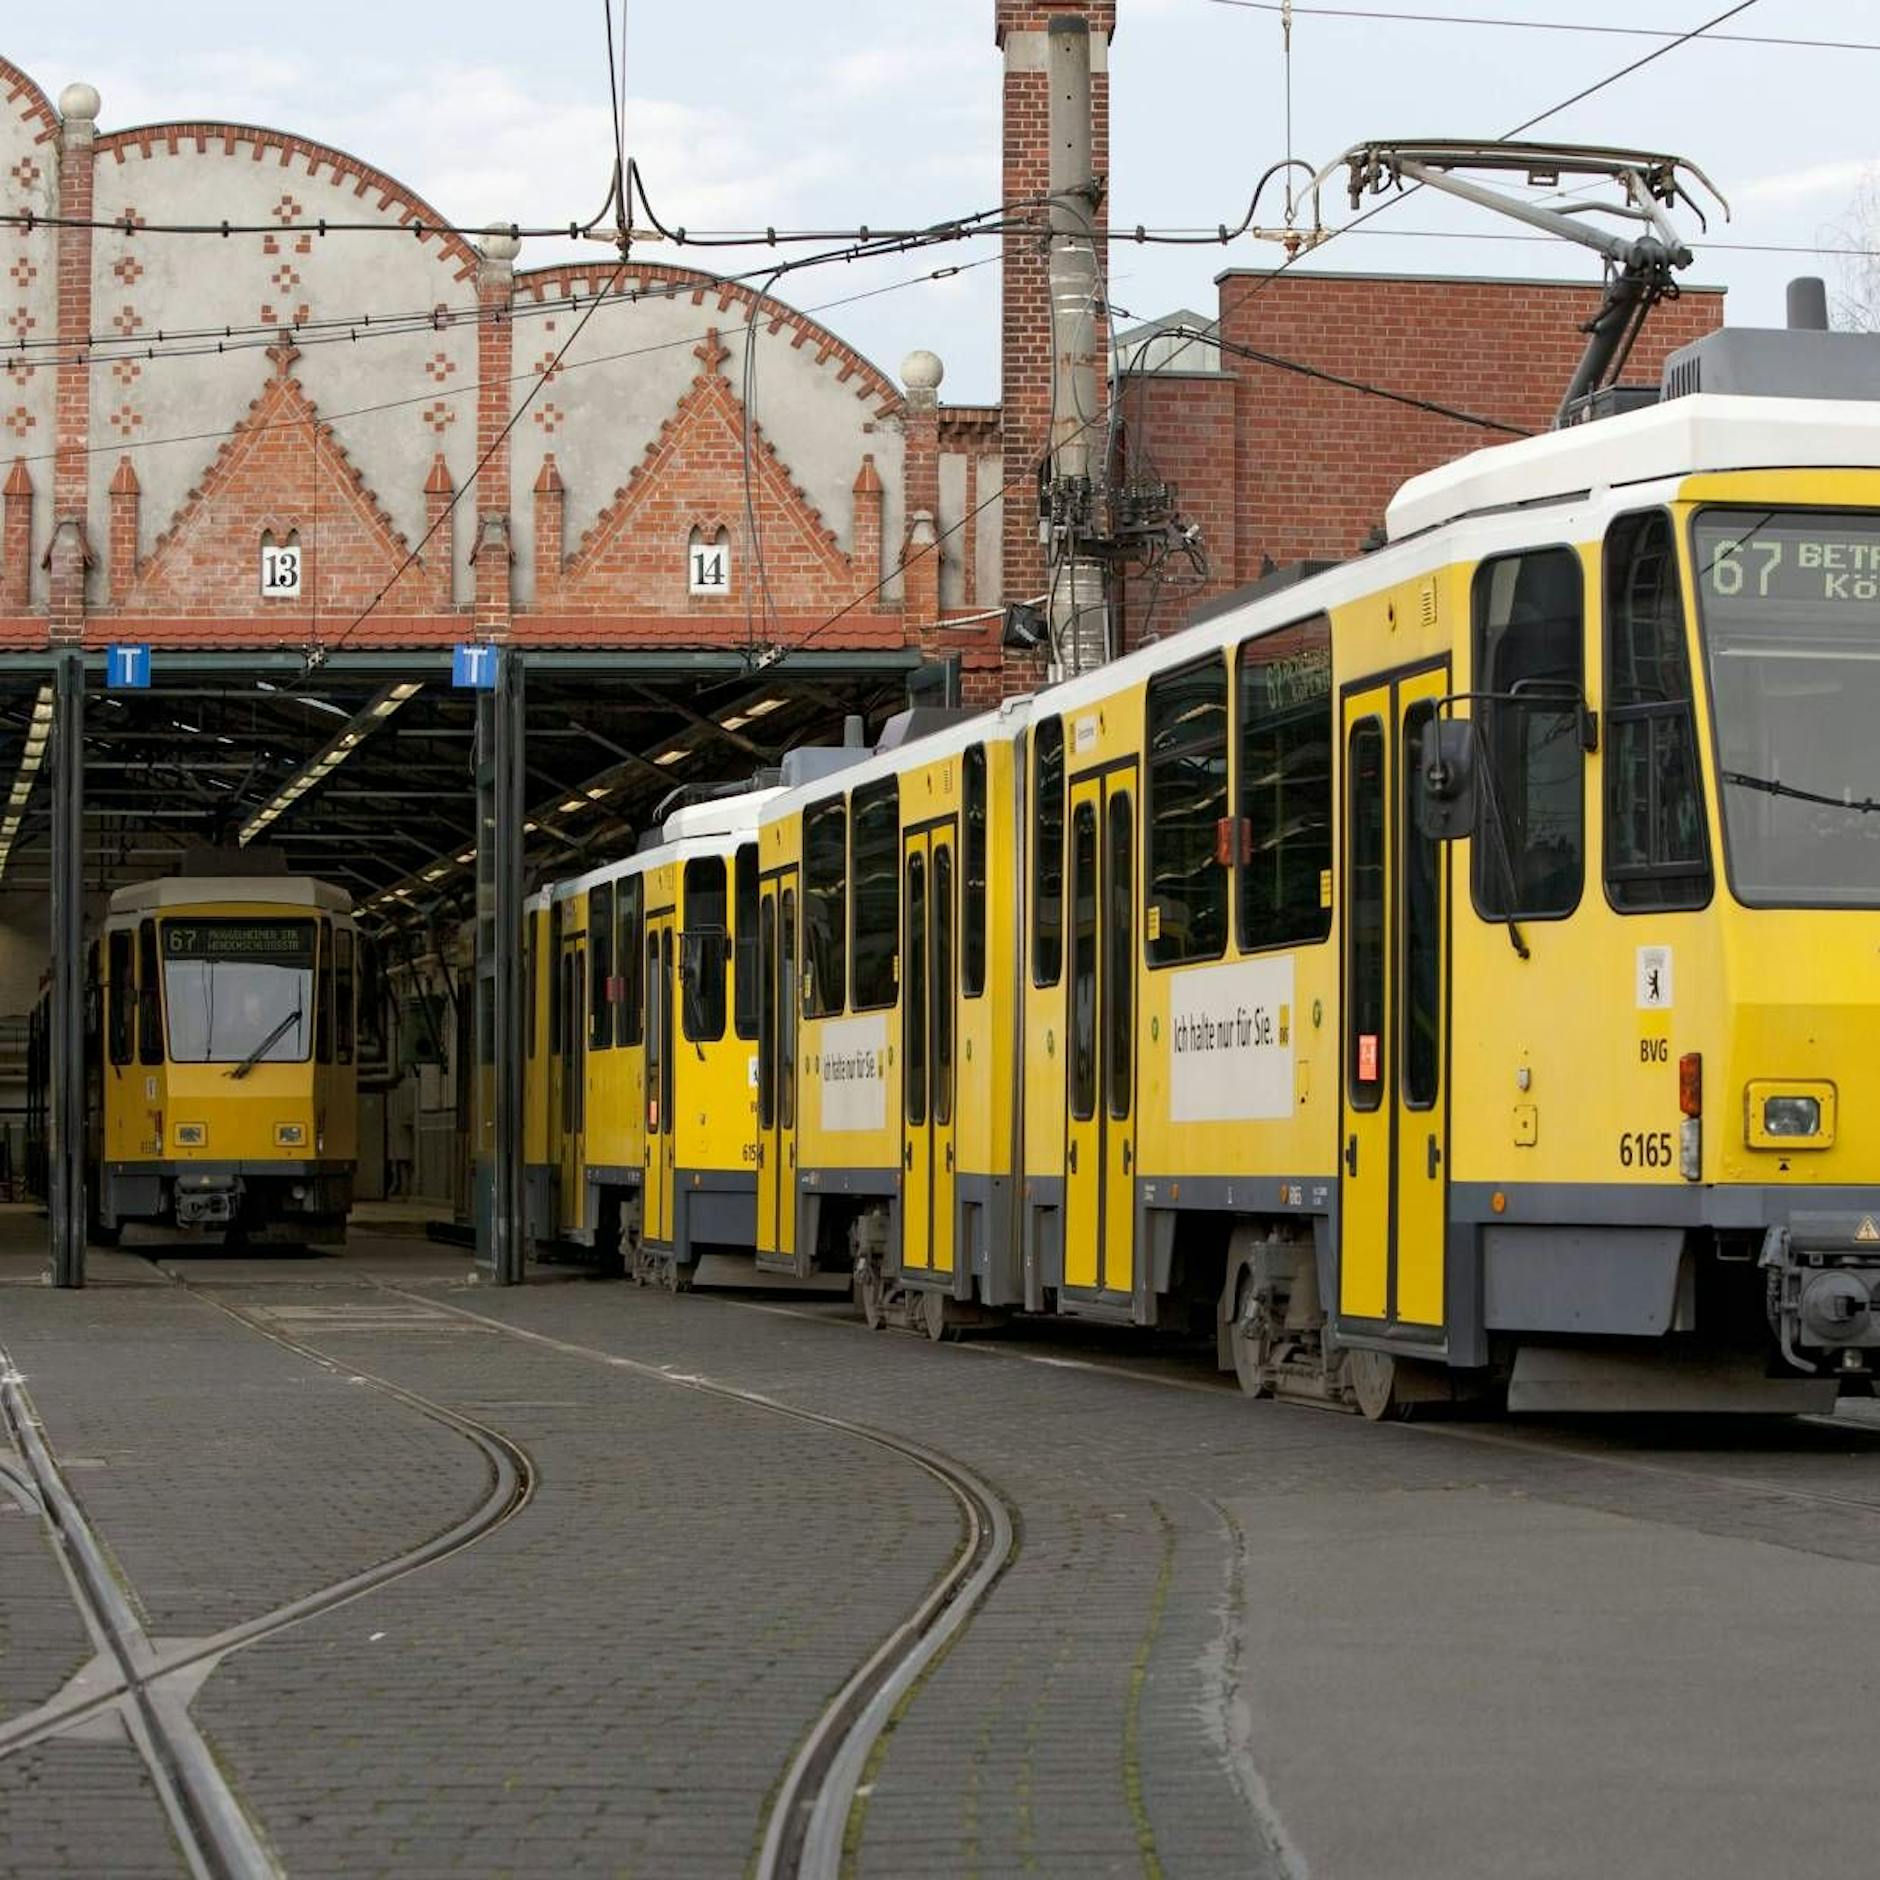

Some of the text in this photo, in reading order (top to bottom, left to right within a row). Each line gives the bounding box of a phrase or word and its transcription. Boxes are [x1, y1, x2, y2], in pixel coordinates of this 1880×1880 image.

[265, 553, 298, 588] 13
[692, 552, 725, 585] 14
[1713, 540, 1782, 597] 67
[116, 648, 142, 684] T
[463, 649, 488, 683] T
[170, 929, 197, 951] 67
[1174, 1014, 1188, 1053] Ich
[1190, 1012, 1215, 1051] halte
[1217, 1021, 1234, 1049] nur
[1236, 1007, 1252, 1047] für
[1640, 1039, 1668, 1063] BVG
[1620, 1132, 1673, 1168] 6165
